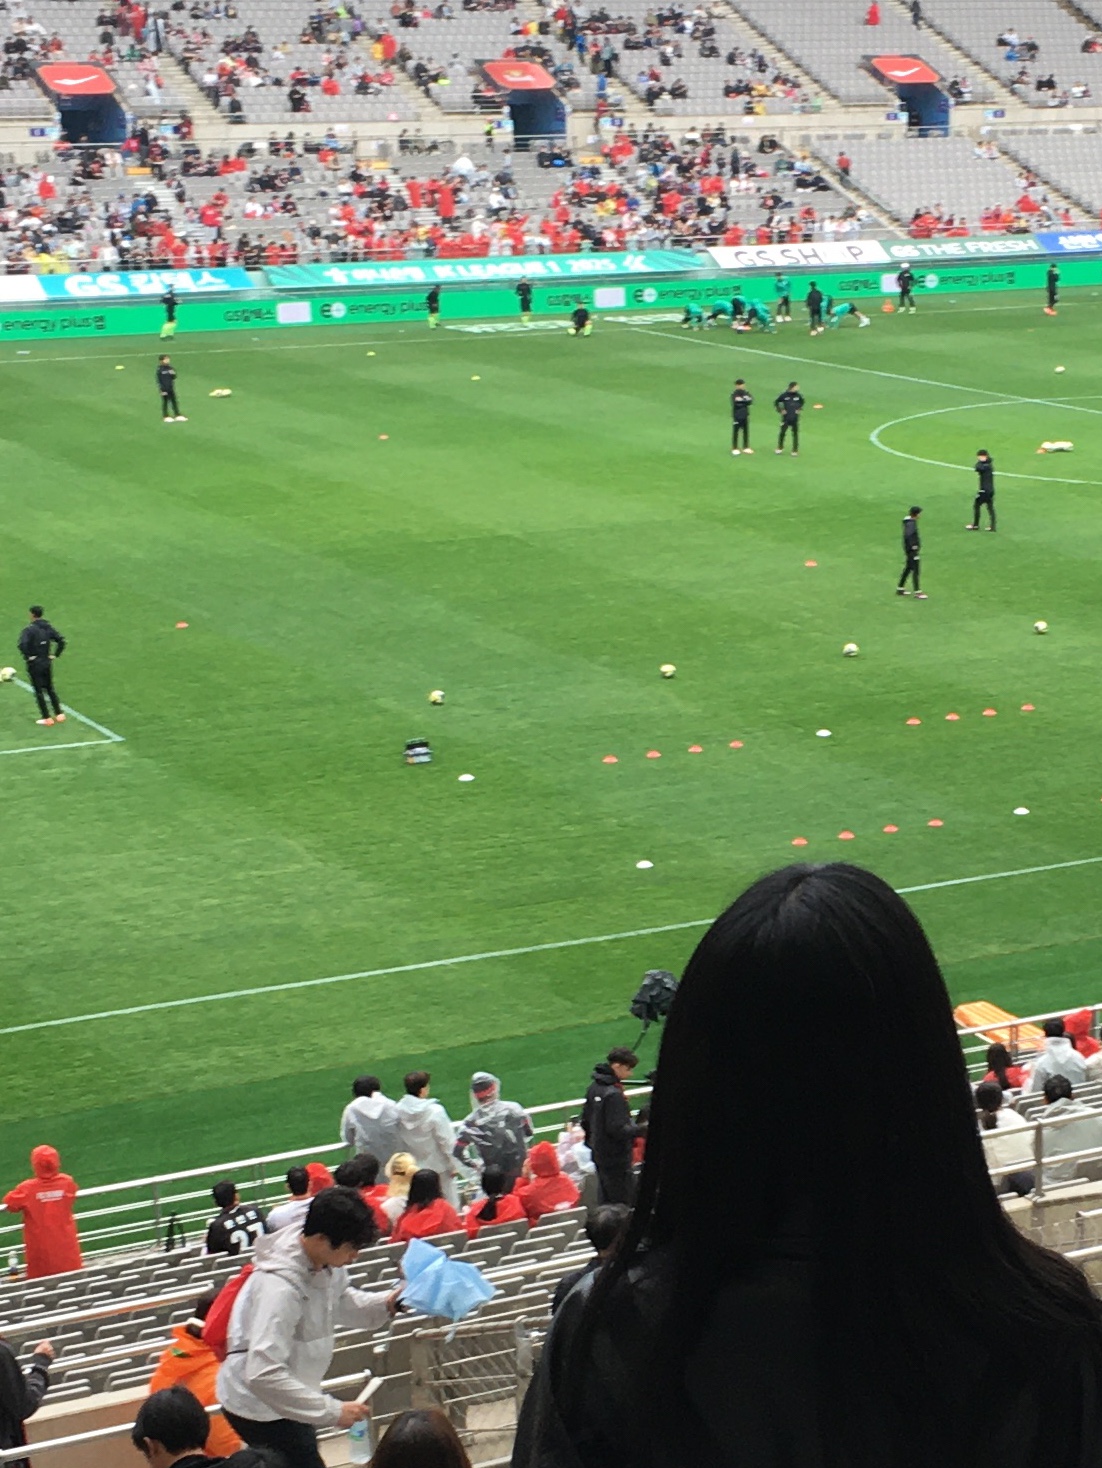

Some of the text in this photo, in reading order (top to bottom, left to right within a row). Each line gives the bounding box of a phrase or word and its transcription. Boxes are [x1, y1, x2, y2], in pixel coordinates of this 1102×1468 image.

[917, 242, 966, 255] THE
[964, 239, 1019, 253] FRESH
[734, 245, 864, 266] GS SHP
[349, 300, 429, 316] energy plus
[3, 319, 55, 333] energy
[230, 1221, 265, 1251] 27
